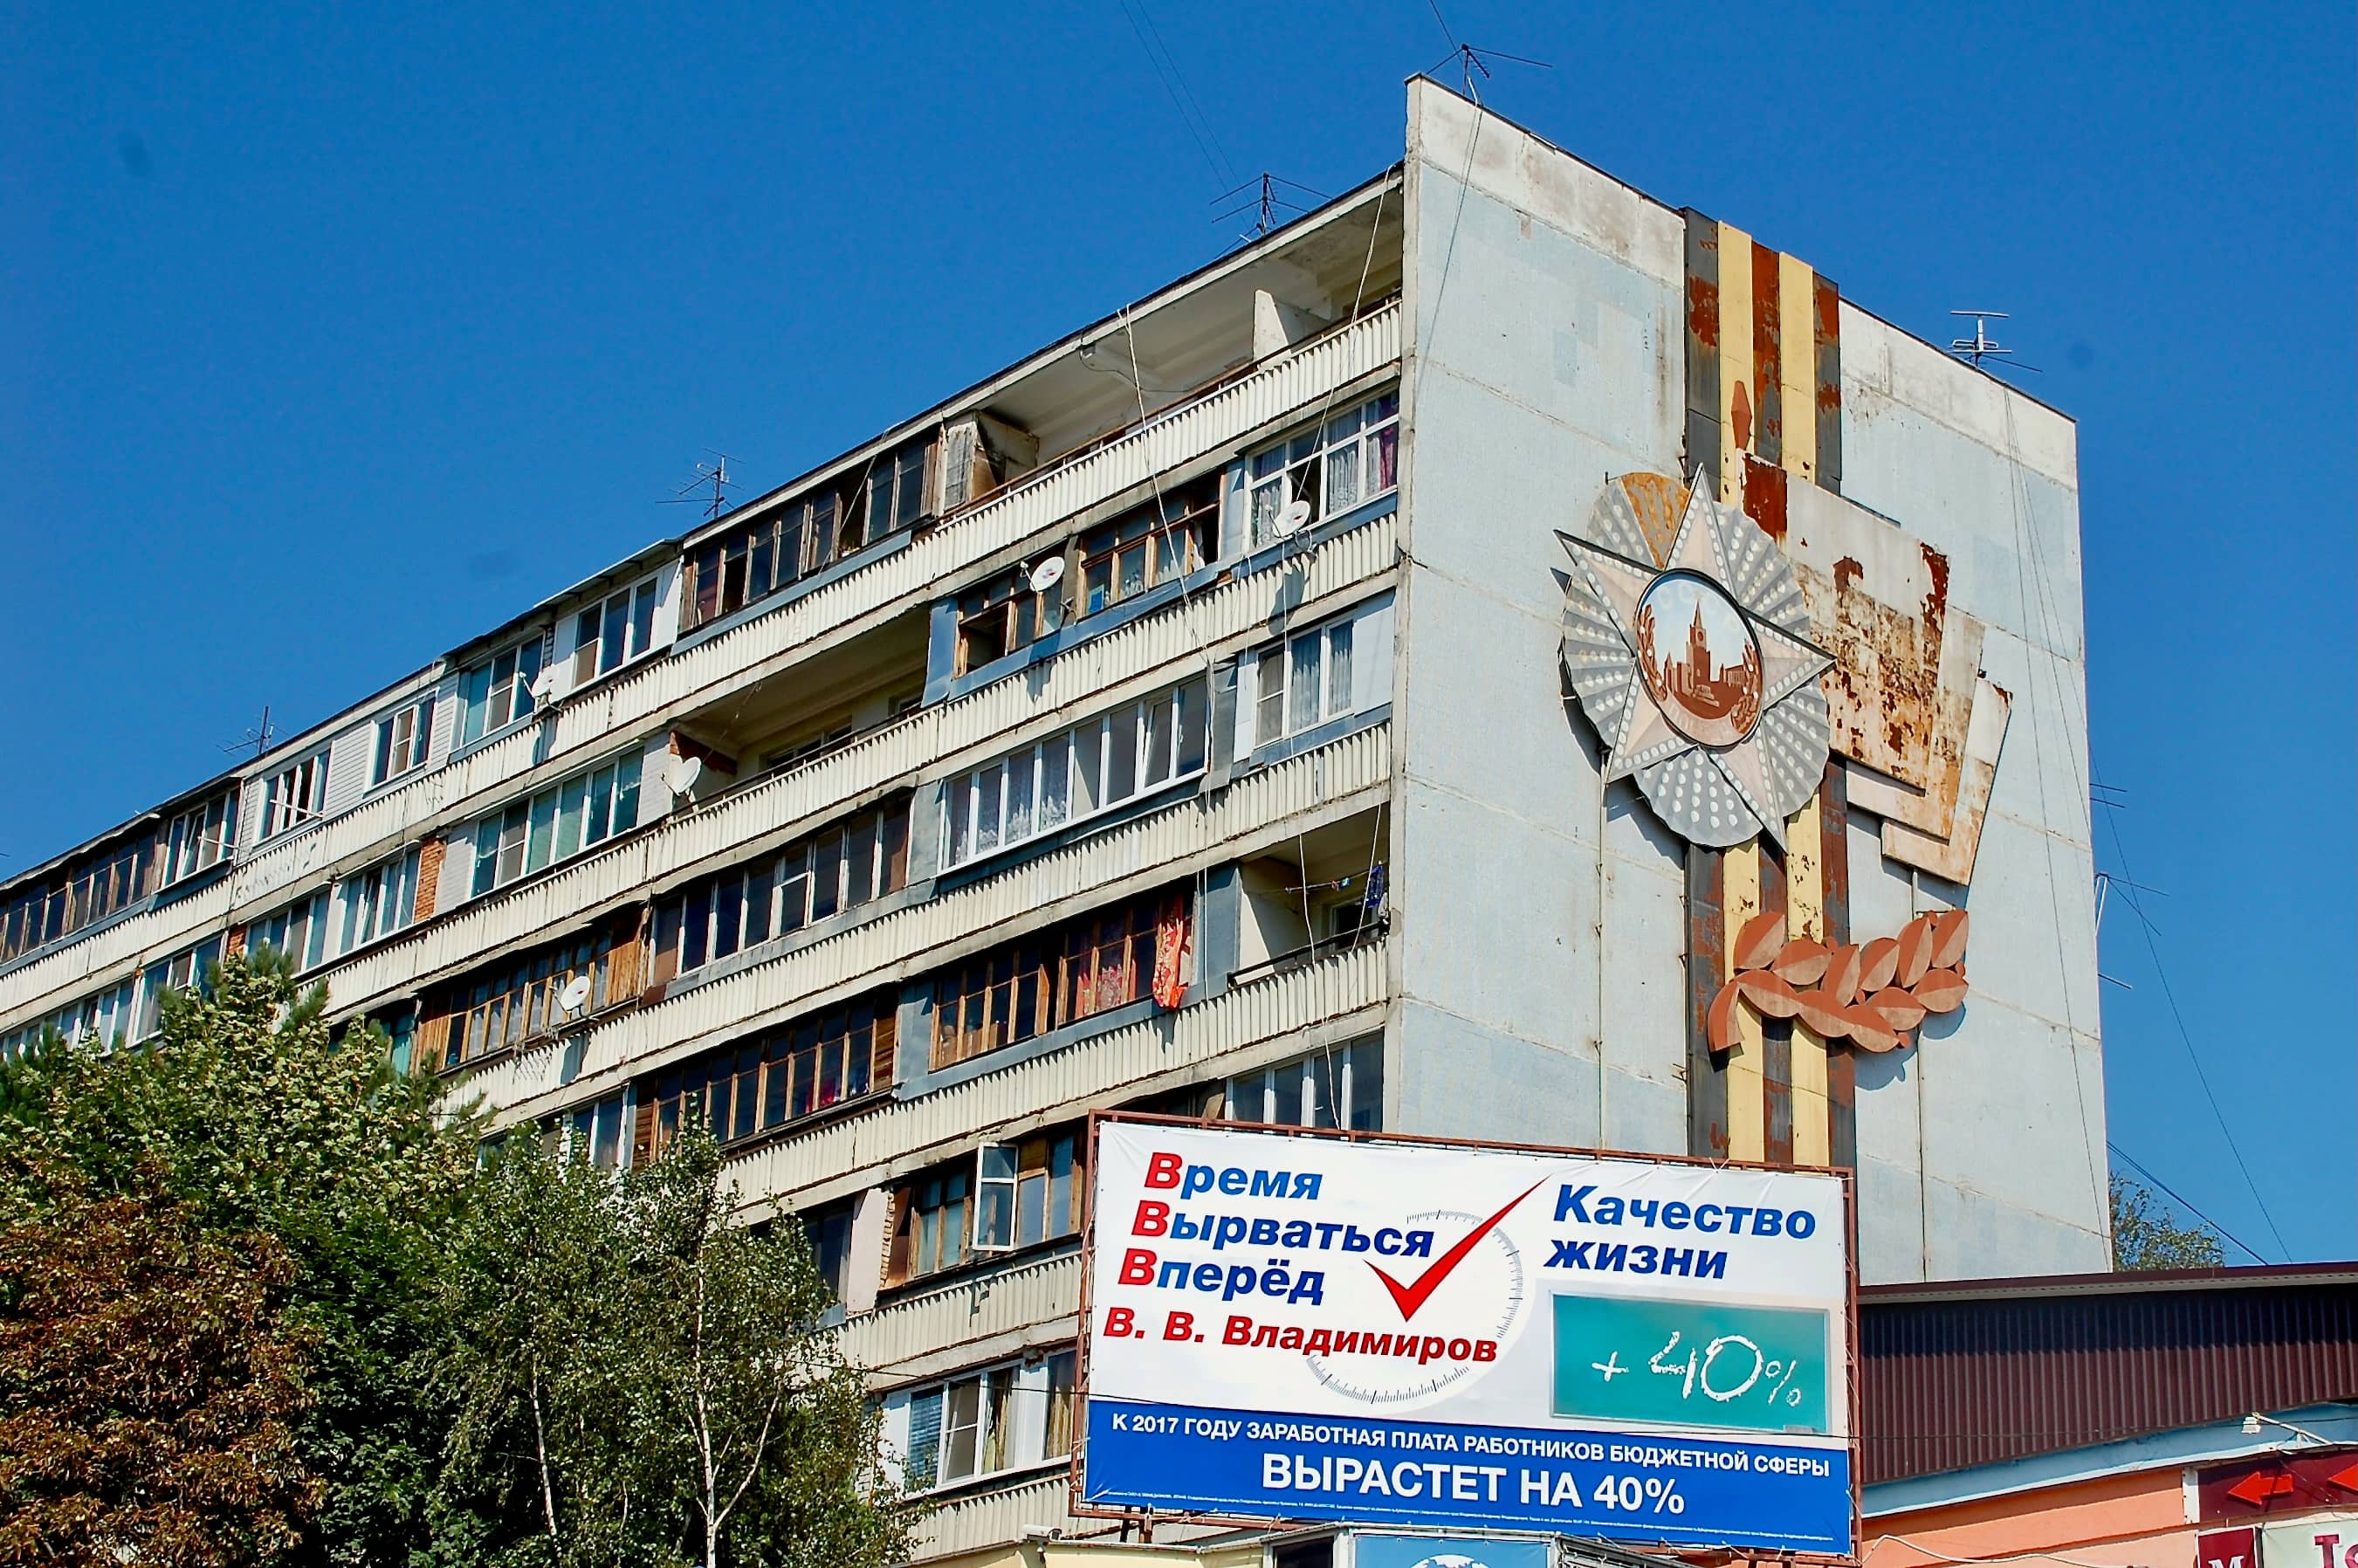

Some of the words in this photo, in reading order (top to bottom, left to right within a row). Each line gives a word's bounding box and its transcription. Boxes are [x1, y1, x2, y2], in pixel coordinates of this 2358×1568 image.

[1145, 1152, 1323, 1200] Время
[1131, 1200, 1434, 1258] Вырваться
[1553, 1184, 1816, 1240] Качество
[1118, 1248, 1325, 1306] Вперёд
[1543, 1239, 1728, 1280] жизни
[1103, 1307, 1145, 1339] В.
[1164, 1310, 1205, 1344] В.
[1222, 1316, 1498, 1365] Владимиров
[1648, 1331, 1802, 1406] 40%
[1112, 1413, 1128, 1431] К
[1132, 1416, 1179, 1434] 2017
[1184, 1418, 1241, 1440] ГОДУ
[1247, 1422, 1386, 1448] ЗАРАБОТНАЯ
[1392, 1431, 1459, 1453] ПЛАТА
[1463, 1434, 1605, 1461] РАБОТНИКОВ
[1610, 1446, 1749, 1471] БЮДЖЕТНОЙ
[1754, 1456, 1831, 1477] СФЕРЫ
[1261, 1453, 1507, 1502] ВЫРАСТЕТ
[1520, 1469, 1583, 1509] НА
[1593, 1475, 1685, 1515] 40%
